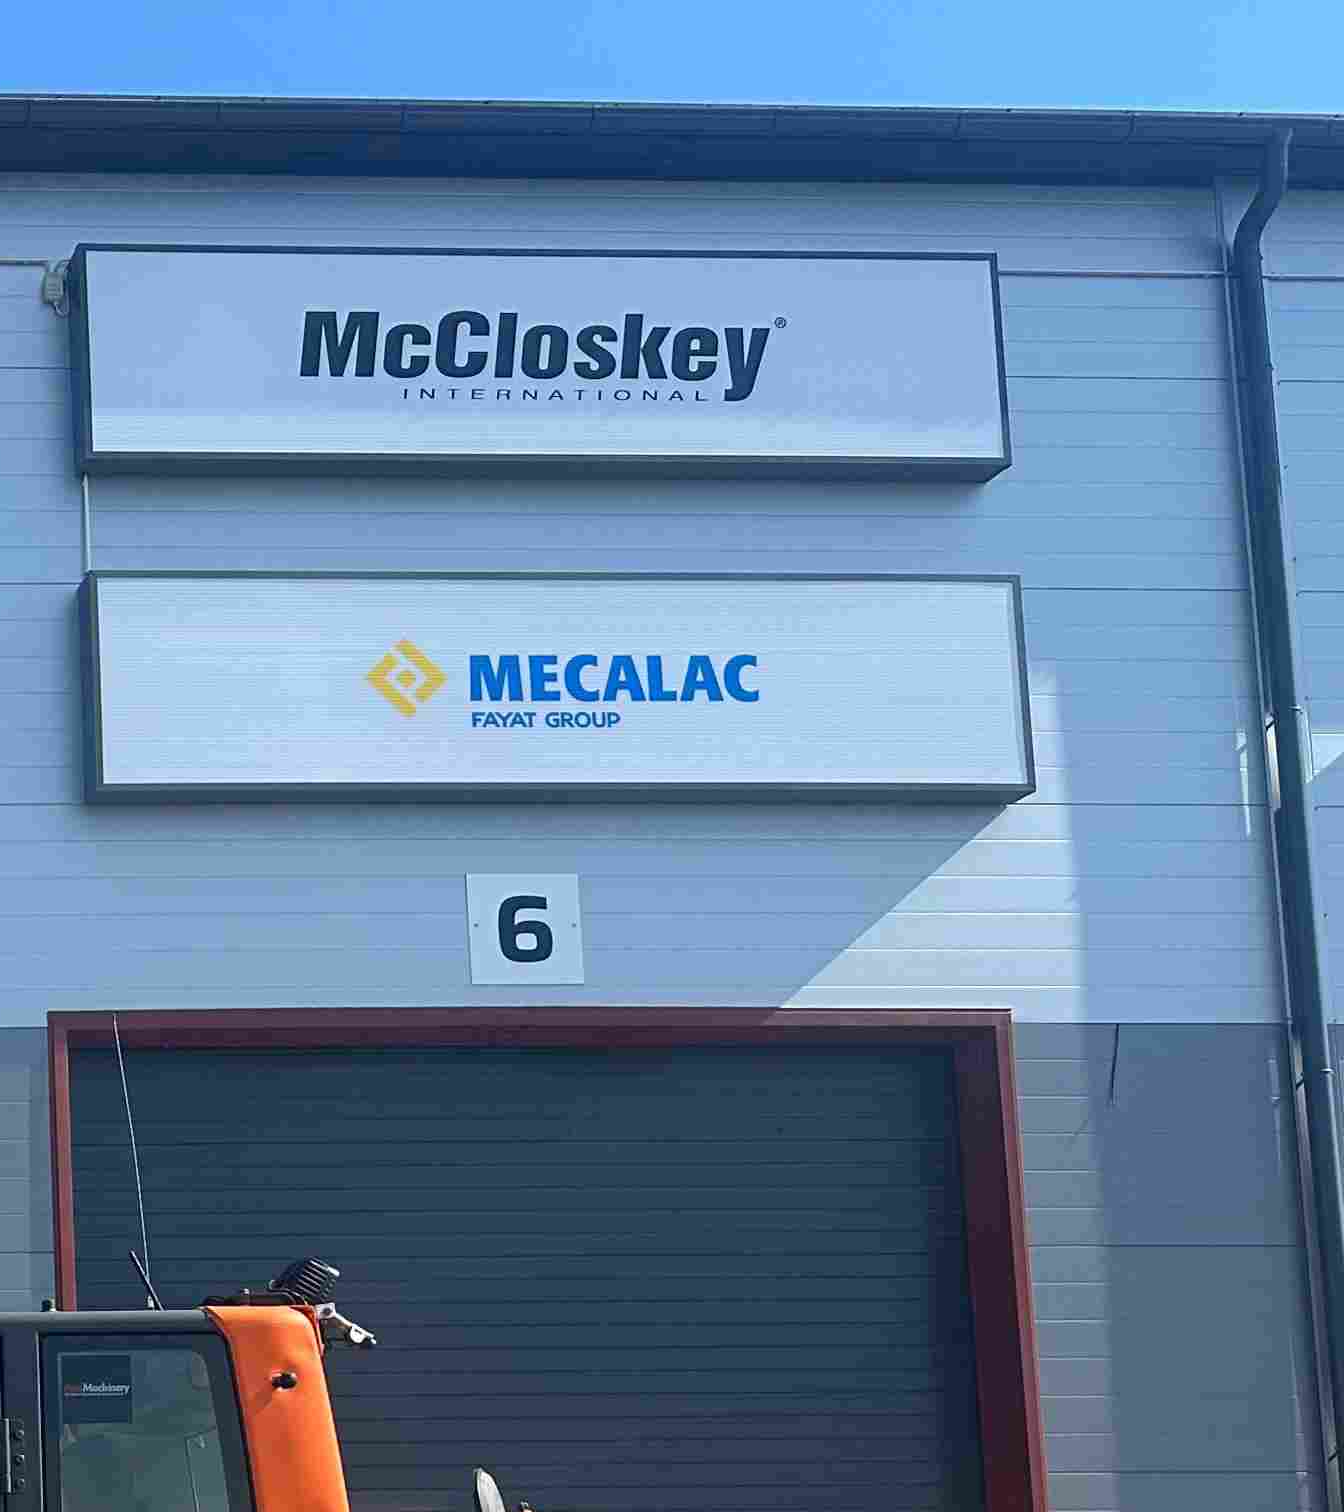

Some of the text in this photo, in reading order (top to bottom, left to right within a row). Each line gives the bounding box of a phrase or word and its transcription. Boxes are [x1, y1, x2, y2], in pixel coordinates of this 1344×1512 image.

[402, 386, 711, 402] INTERNATIONAL
[468, 653, 761, 704] MECALAC
[471, 710, 622, 729] FAYAT GROUP
[495, 893, 555, 964] 6
